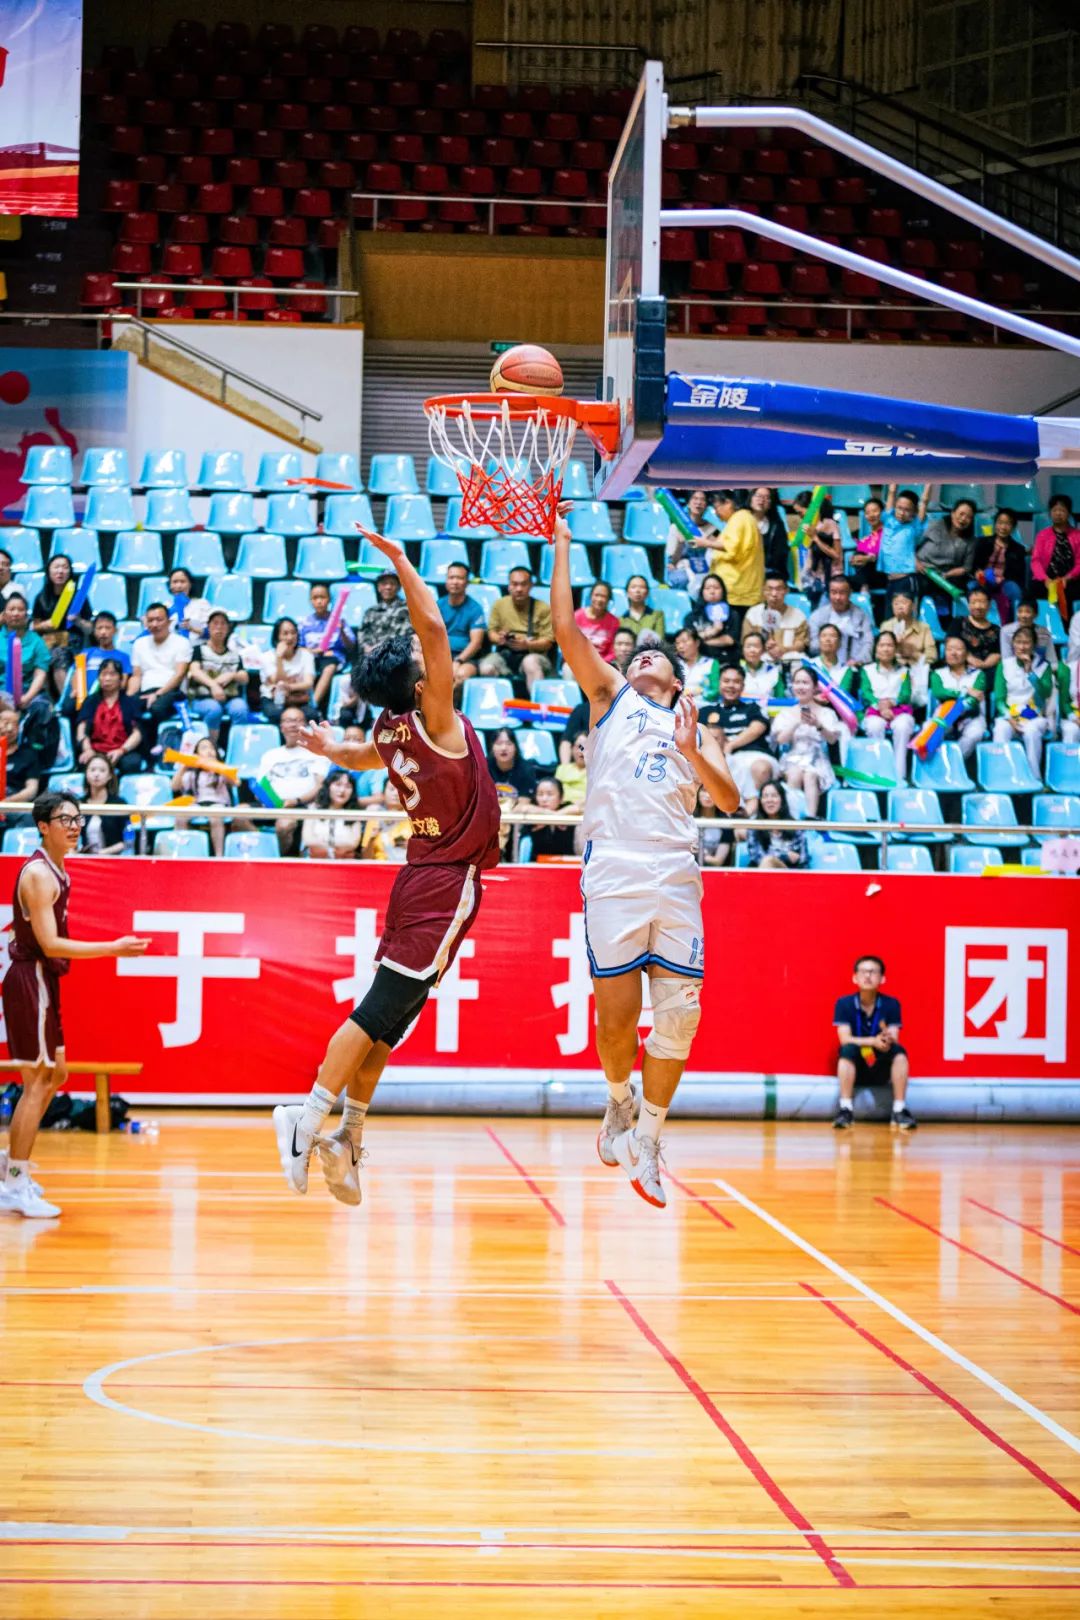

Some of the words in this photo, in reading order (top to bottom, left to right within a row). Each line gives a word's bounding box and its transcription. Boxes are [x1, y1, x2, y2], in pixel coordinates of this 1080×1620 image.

[690, 384, 749, 409] 金陵
[391, 749, 420, 810] 5
[634, 751, 667, 782] 13
[943, 925, 1068, 1064] 团
